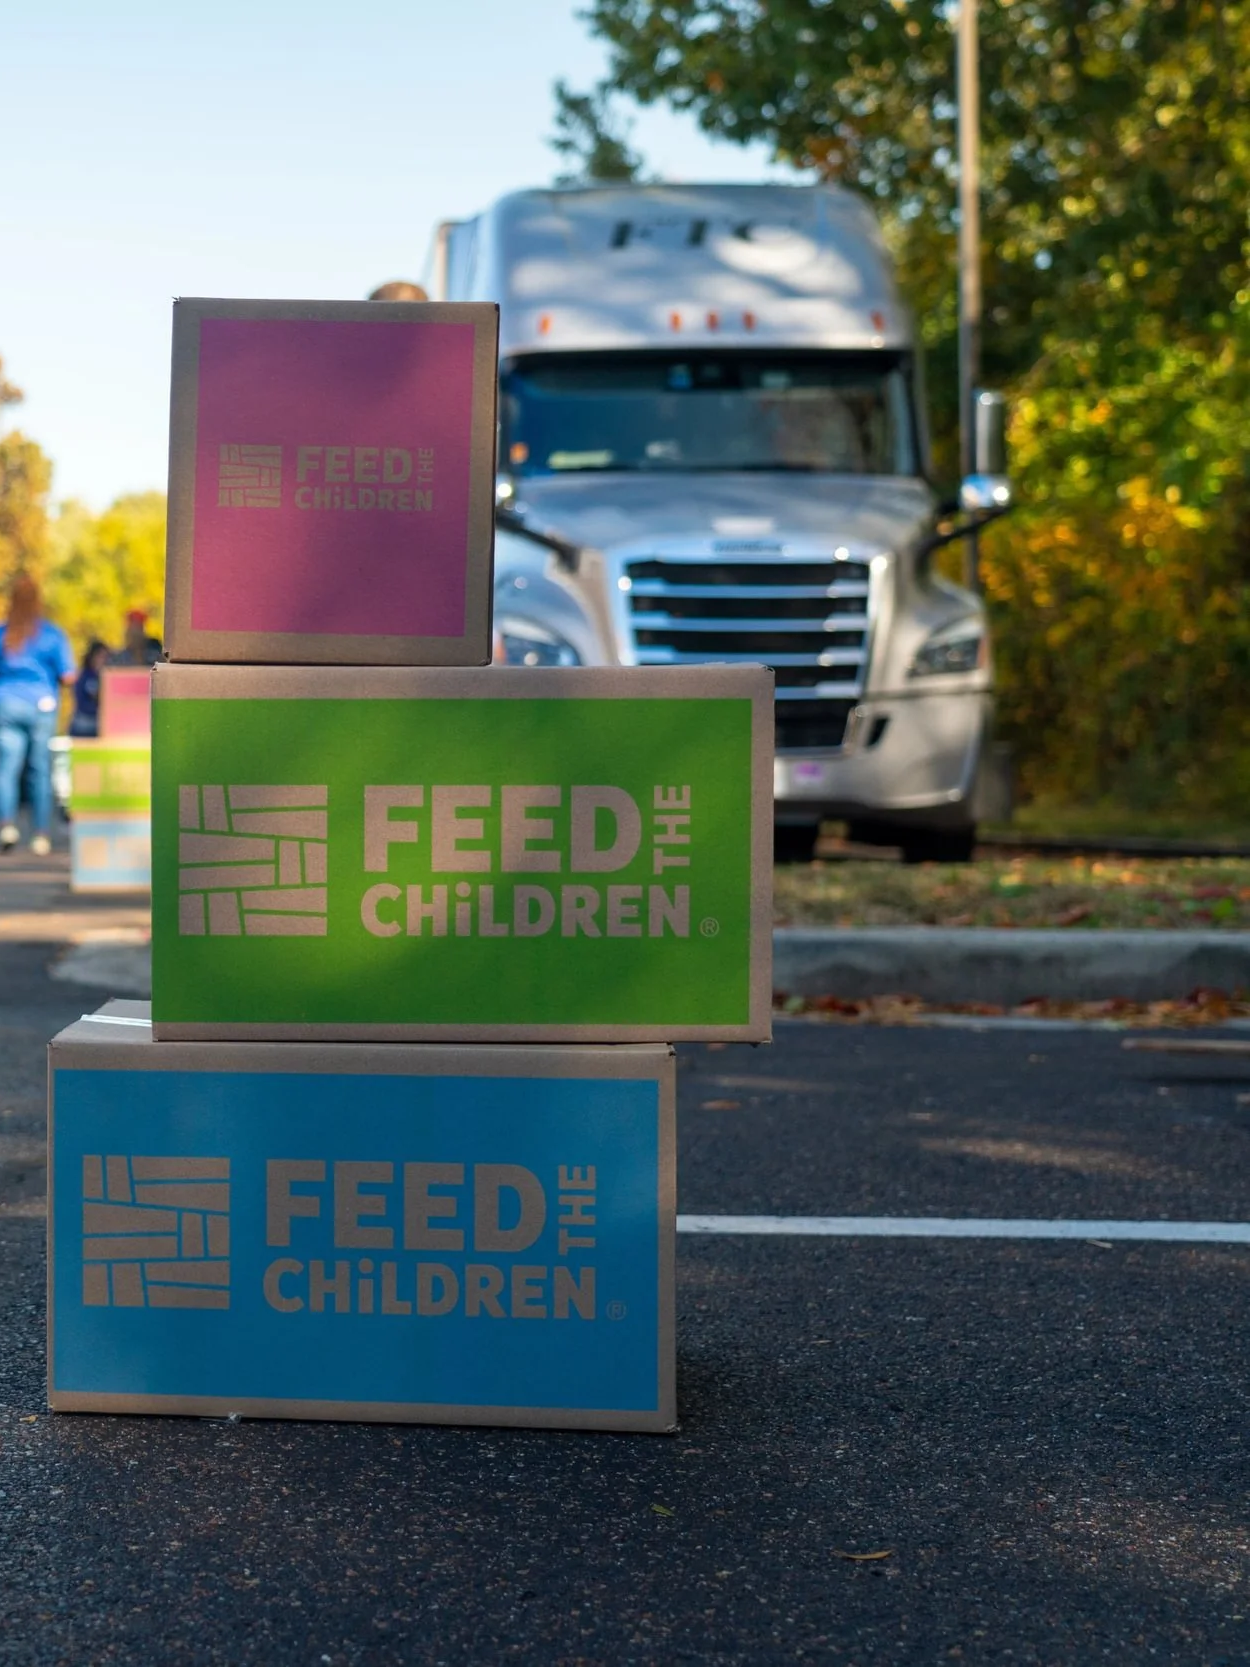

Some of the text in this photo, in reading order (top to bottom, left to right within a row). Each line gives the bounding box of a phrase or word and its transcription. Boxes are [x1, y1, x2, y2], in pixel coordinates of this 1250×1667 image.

[296, 446, 434, 486] FEED THE
[364, 785, 691, 875] FEED THE
[267, 1160, 596, 1255] FEED THE
